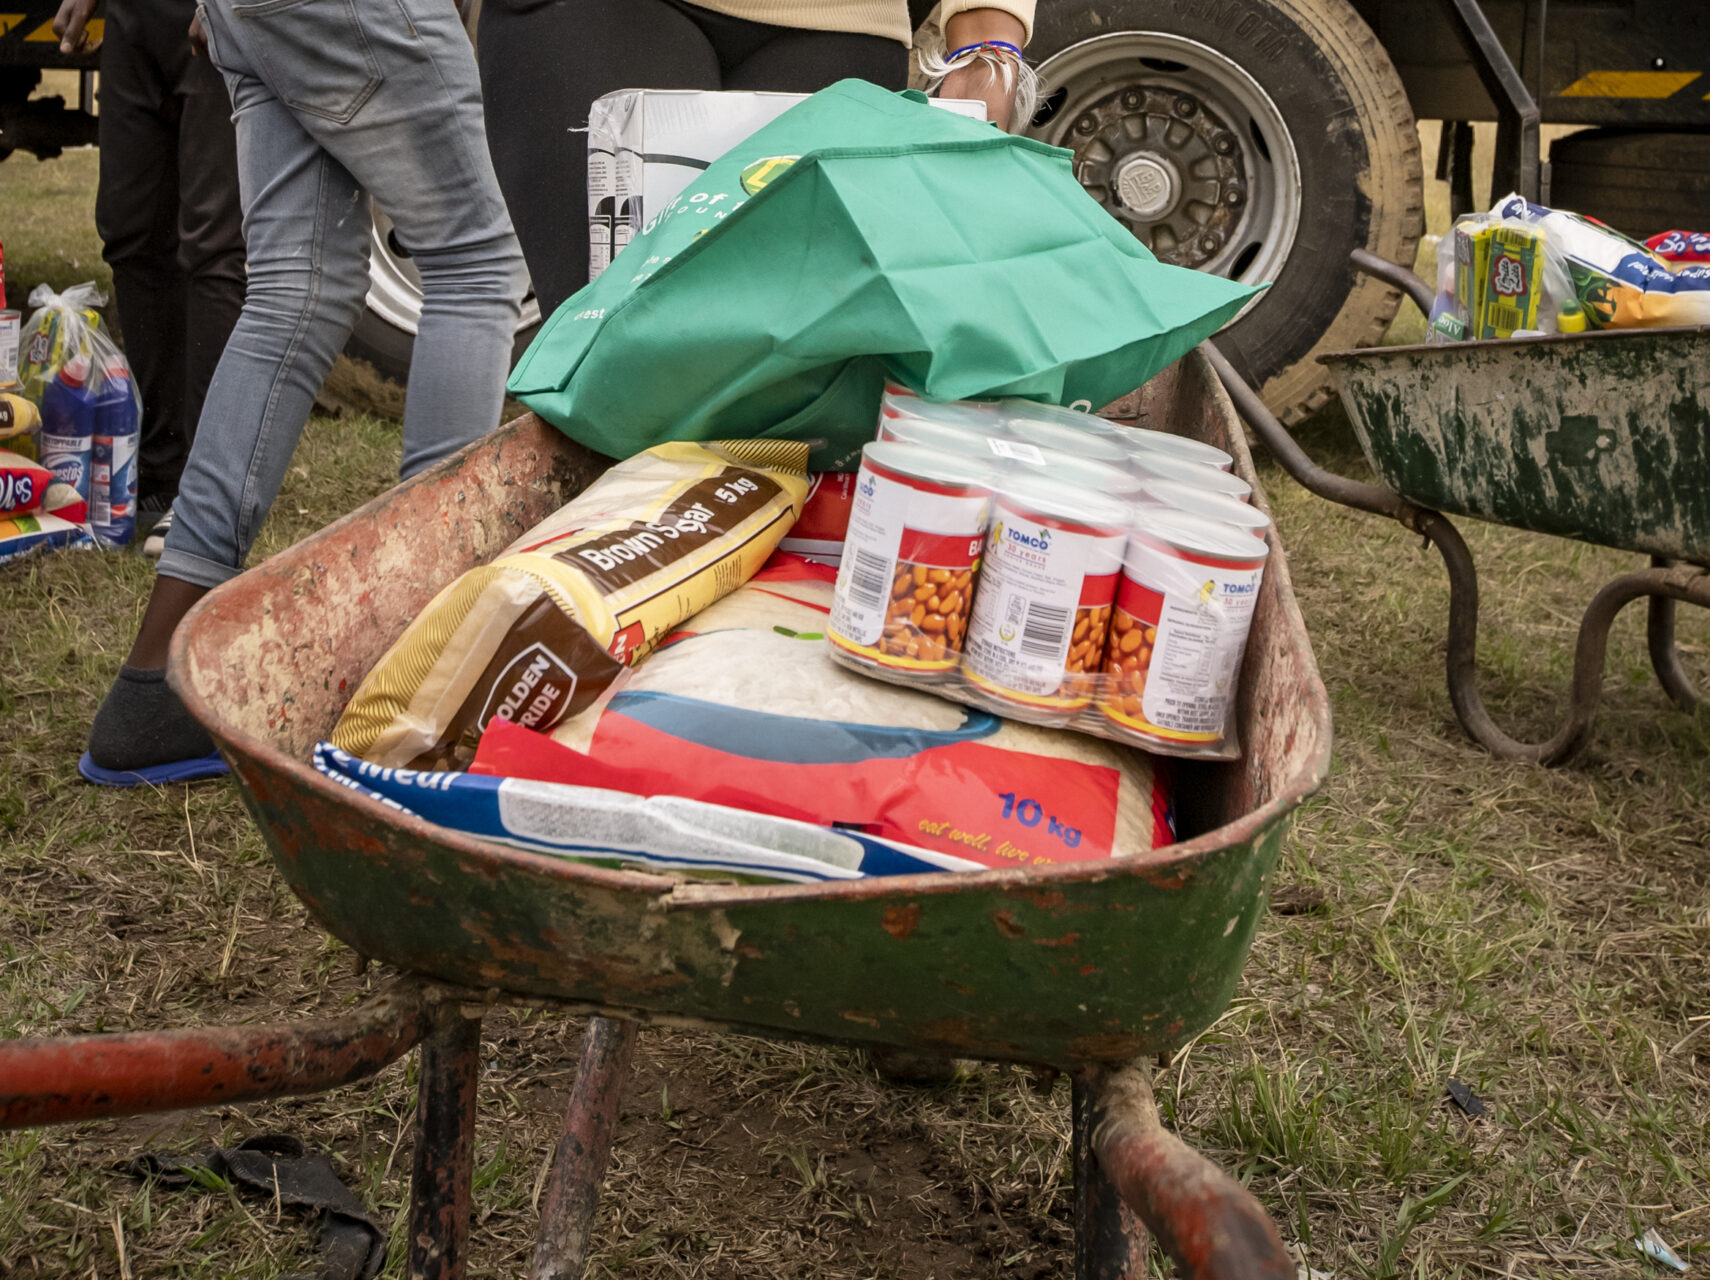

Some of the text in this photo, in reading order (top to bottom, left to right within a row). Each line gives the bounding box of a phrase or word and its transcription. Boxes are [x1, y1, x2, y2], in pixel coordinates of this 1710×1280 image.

[690, 192, 728, 205] of
[1438, 316, 1461, 335] Aloe
[579, 477, 758, 571] Brown Sgar 5 kg
[1008, 528, 1048, 550] TOMCO
[497, 655, 551, 721] OLDEN
[918, 819, 950, 837] eat
[995, 840, 1030, 862] live
[998, 792, 1082, 848] 10 kg
